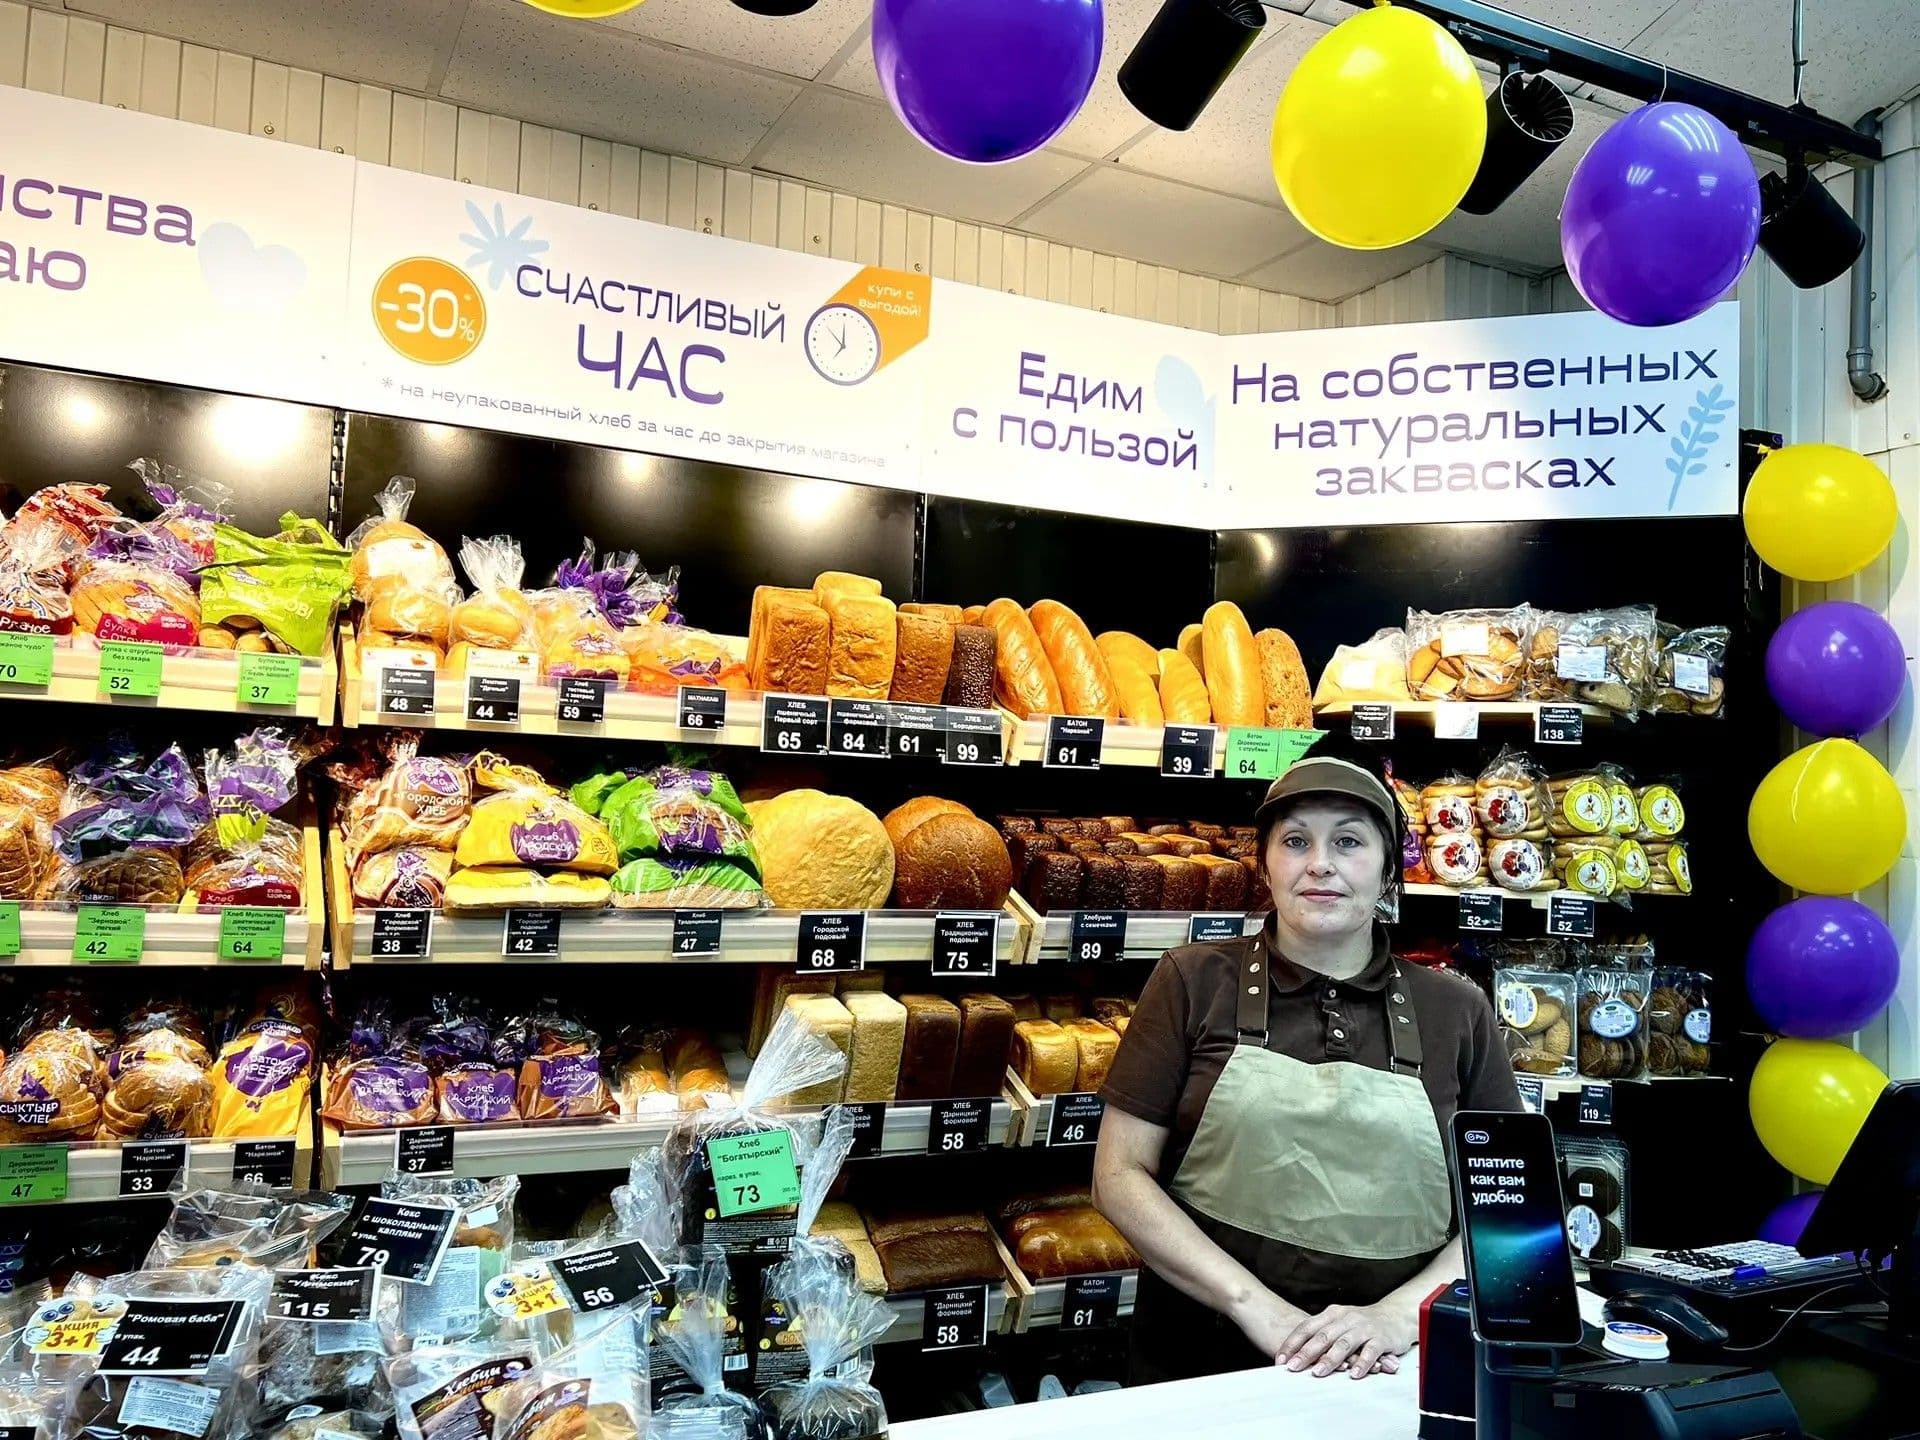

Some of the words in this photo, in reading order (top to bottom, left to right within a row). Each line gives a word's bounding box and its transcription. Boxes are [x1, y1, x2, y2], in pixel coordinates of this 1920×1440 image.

[0, 174, 196, 247] ства
[867, 284, 901, 298] купи
[905, 290, 914, 300] с
[515, 263, 786, 343] СЧАСТЛИВЫЙ
[858, 298, 922, 317] выгодой!
[577, 323, 726, 405] ЧАС
[1231, 363, 1301, 404] На
[1321, 347, 1719, 402] собственных
[1017, 351, 1144, 415] Едим
[400, 383, 424, 398] на
[431, 386, 582, 421] неупакованный
[588, 411, 632, 429] хлеб
[637, 418, 657, 433] за
[663, 424, 694, 439] час
[699, 430, 721, 443] до
[727, 434, 806, 455] закрытия
[811, 447, 886, 468] магазина
[1273, 403, 1668, 459] натуральных
[951, 406, 979, 439] с
[998, 412, 1198, 471] пользой
[1314, 456, 1616, 497] заквасках
[110, 676, 130, 690] 52
[251, 685, 270, 699] 37
[389, 697, 408, 711] 48
[787, 701, 807, 709] ХЛЕБ
[852, 703, 871, 711] ХЛЕБ
[475, 705, 495, 718] 44
[563, 706, 580, 719] 59
[687, 714, 703, 727] 66
[774, 715, 801, 724] Первый
[1066, 719, 1088, 727] БАТОН
[1358, 725, 1372, 737] 79
[1543, 729, 1564, 740] 138
[777, 731, 802, 750] 65
[842, 732, 865, 751] 84
[899, 734, 920, 753] 61
[957, 743, 979, 761] 99
[1058, 747, 1077, 764] 61
[1173, 756, 1192, 773] 39
[1239, 759, 1257, 774] 64
[416, 805, 447, 817] ХЛЕБ
[822, 917, 842, 925] ХЛЕБ
[956, 921, 975, 929] ХЛЕБ
[1467, 915, 1481, 926] 52
[1557, 920, 1573, 932] 52
[812, 925, 850, 934] Городской
[941, 929, 989, 937] Традиционный
[814, 933, 847, 941] подовый
[949, 936, 979, 944] подовый
[85, 941, 107, 955] 42
[233, 941, 253, 954] 64
[381, 940, 401, 953] 38
[515, 938, 534, 951] 42
[680, 938, 698, 951] 47
[1080, 942, 1102, 960] 89
[811, 949, 835, 968] 68
[946, 951, 969, 970] 75
[555, 1064, 582, 1074] хлеб
[467, 1083, 495, 1094] хлеб
[940, 1109, 982, 1118] "Дарницкий"
[1583, 1108, 1599, 1120] 119
[1063, 1124, 1084, 1141] 46
[737, 1138, 761, 1149] Хлеб
[941, 1132, 964, 1150] 58
[717, 1146, 784, 1163] "Богатырский"
[408, 1158, 427, 1172] 37
[1467, 1157, 1525, 1169] платите
[131, 1176, 153, 1191] 33
[243, 1172, 264, 1186] 66
[1469, 1174, 1496, 1186] как
[1498, 1175, 1525, 1187] вам
[11, 1183, 33, 1198] 47
[733, 1184, 761, 1206] 73
[1471, 1189, 1525, 1206] удобно
[397, 1207, 421, 1218] Кекс
[371, 1216, 446, 1233] шоколадными
[356, 1246, 390, 1268] 79
[563, 1250, 613, 1267] Пирожное
[1083, 1279, 1105, 1287] БАТОН
[515, 1284, 548, 1302] АКЦИЯ
[582, 1287, 615, 1307] 56
[946, 1292, 965, 1300] ХЛЕБ
[278, 1301, 330, 1317] 115
[517, 1293, 558, 1313] 3+1
[934, 1300, 976, 1310] "Дарницкий"
[127, 1313, 186, 1324] "Ромовая
[188, 1313, 225, 1323] баба"
[1073, 1308, 1093, 1327] 61
[54, 1320, 100, 1332] АКЦИЯ
[45, 1331, 96, 1348] 3+1
[936, 1325, 959, 1345] 58
[121, 1346, 162, 1366] 44
